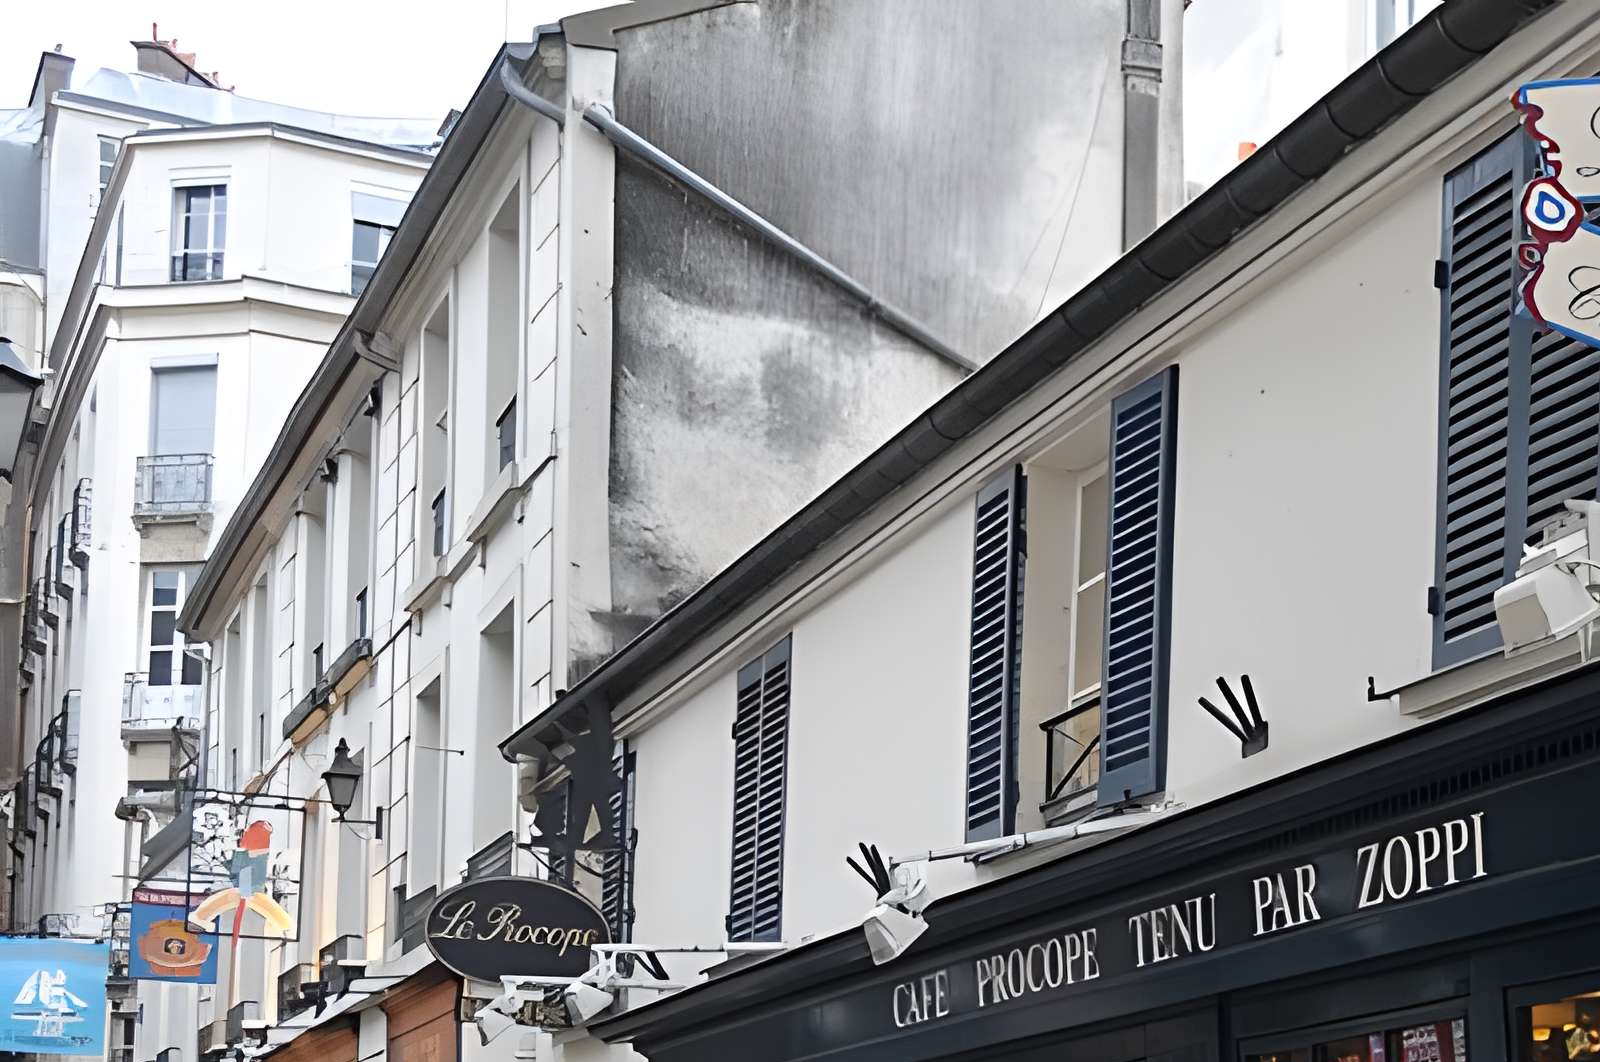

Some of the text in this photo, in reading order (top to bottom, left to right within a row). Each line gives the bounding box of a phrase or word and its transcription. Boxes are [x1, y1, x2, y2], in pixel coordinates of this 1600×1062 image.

[430, 900, 600, 957] Le Procope
[976, 928, 1100, 1007] PROCOPE
[1129, 894, 1217, 968] TENU
[1253, 864, 1321, 936] PAR
[1356, 812, 1488, 910] ZOPPI
